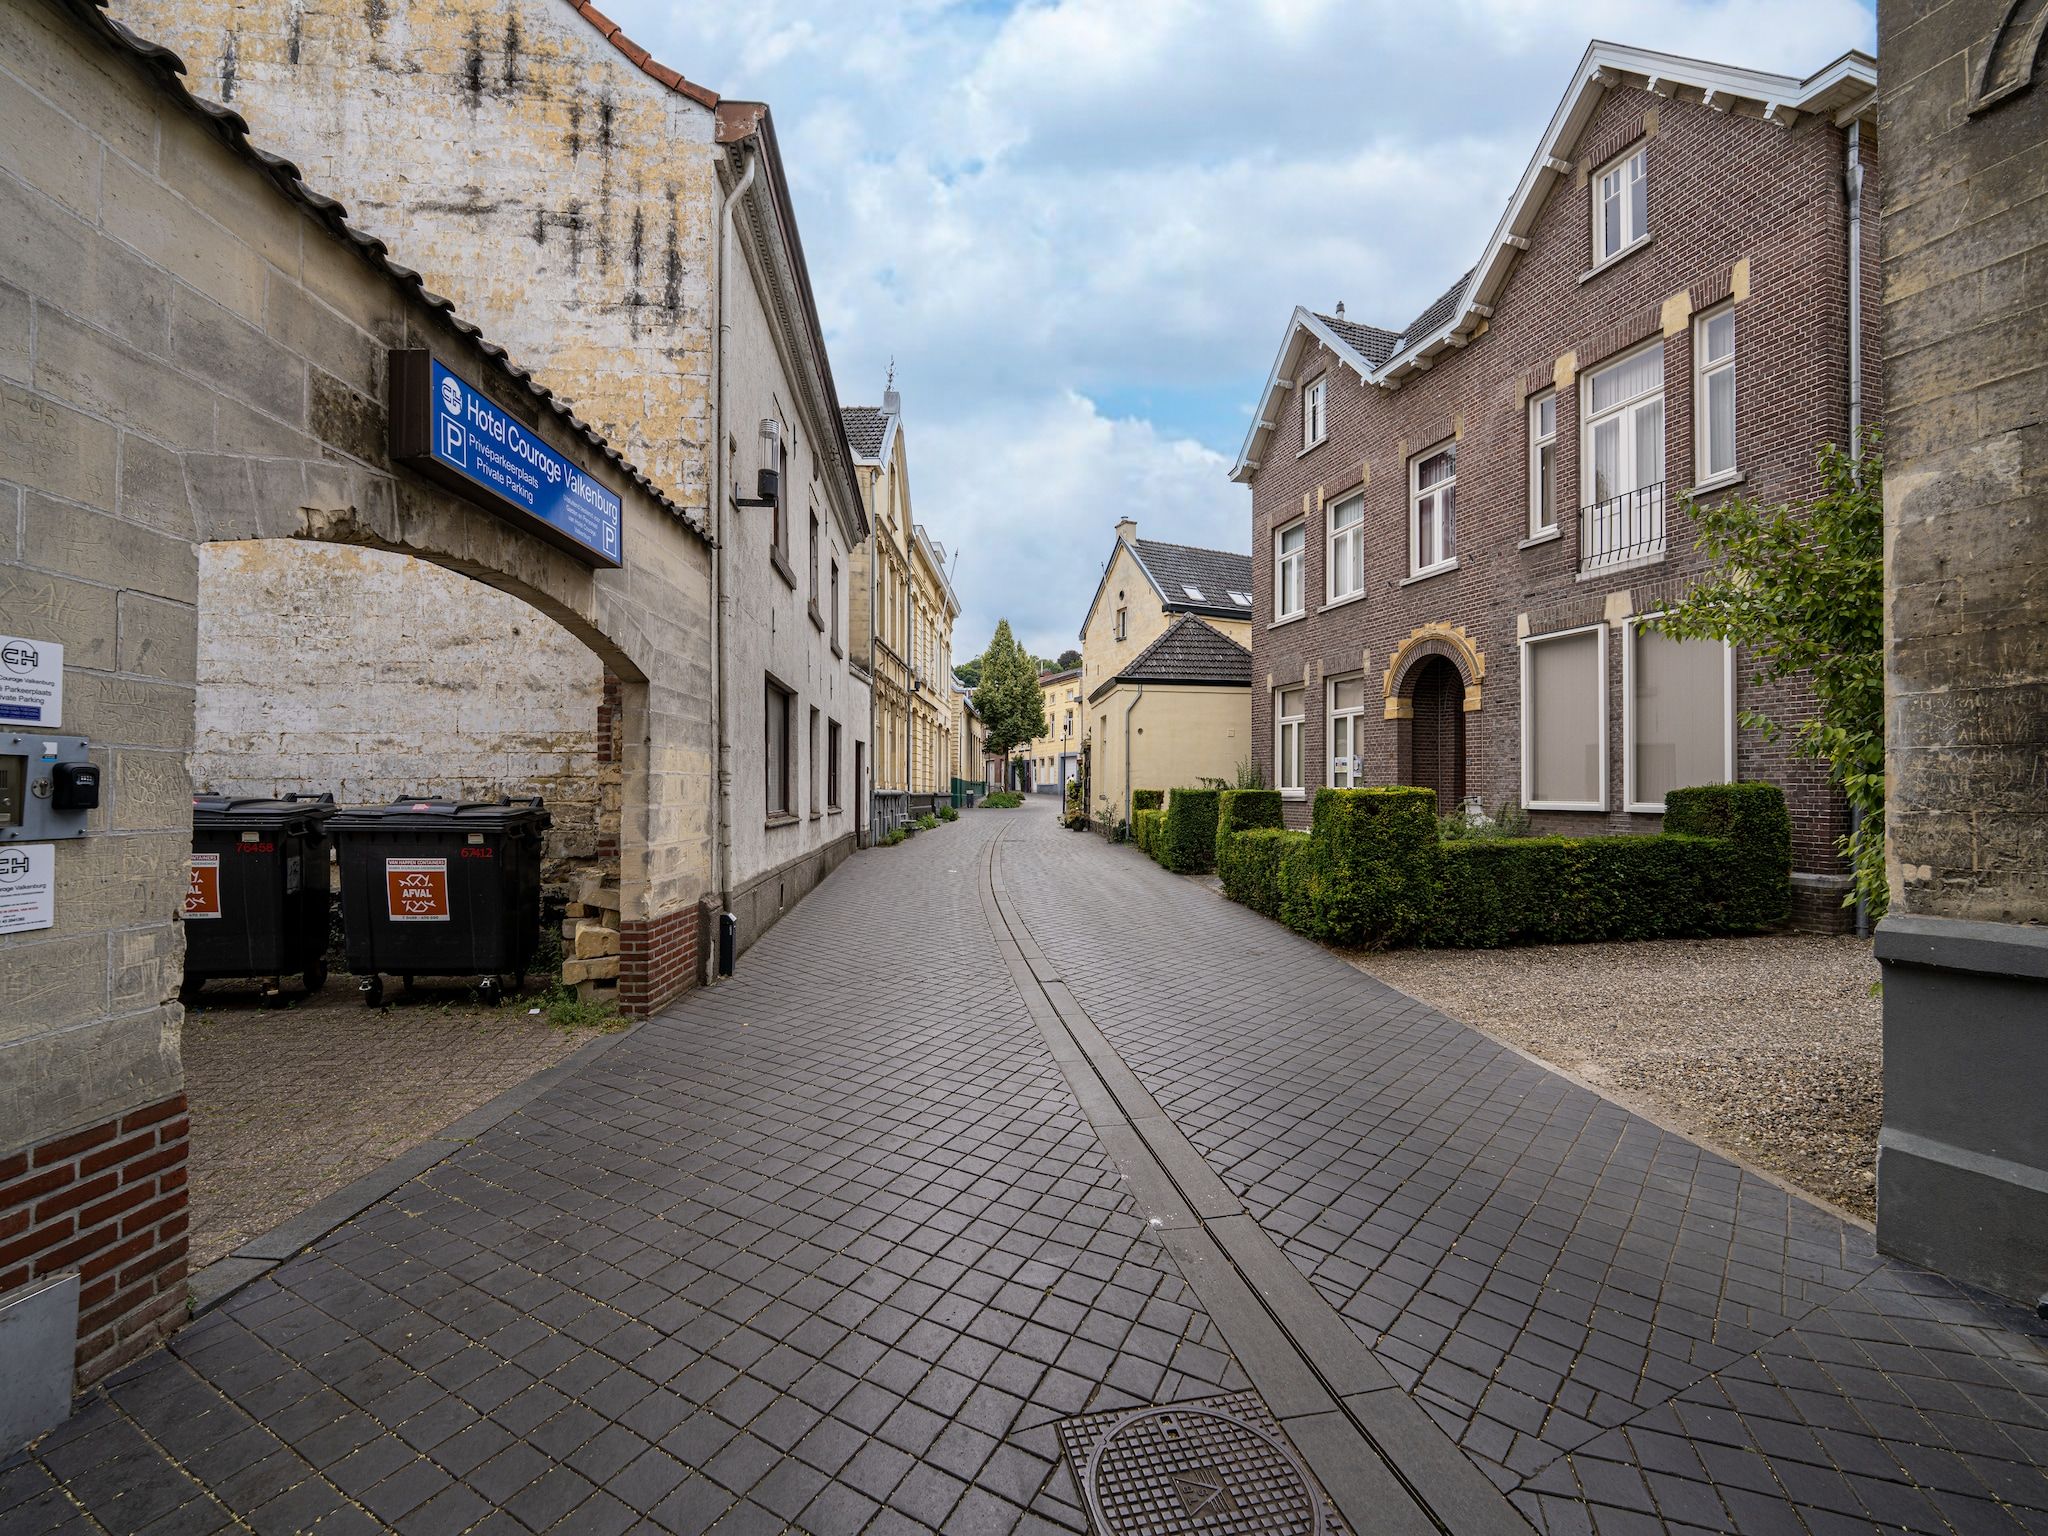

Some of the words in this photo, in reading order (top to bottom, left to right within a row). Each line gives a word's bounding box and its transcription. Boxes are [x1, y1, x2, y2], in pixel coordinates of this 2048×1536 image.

[446, 421, 463, 455] P
[467, 393, 506, 445] Hotel
[508, 425, 562, 483] Courage
[563, 463, 618, 526] Valkenburg
[468, 433, 539, 489] Privéparkeerplaats
[476, 456, 505, 485] Private
[505, 475, 534, 505] Parking
[605, 526, 615, 550] P
[4, 685, 52, 697] Parkeerplaats
[24, 677, 55, 687] Valkenburg
[18, 695, 45, 705] Parking
[188, 885, 202, 895] AL
[402, 888, 433, 898] AFVAL
